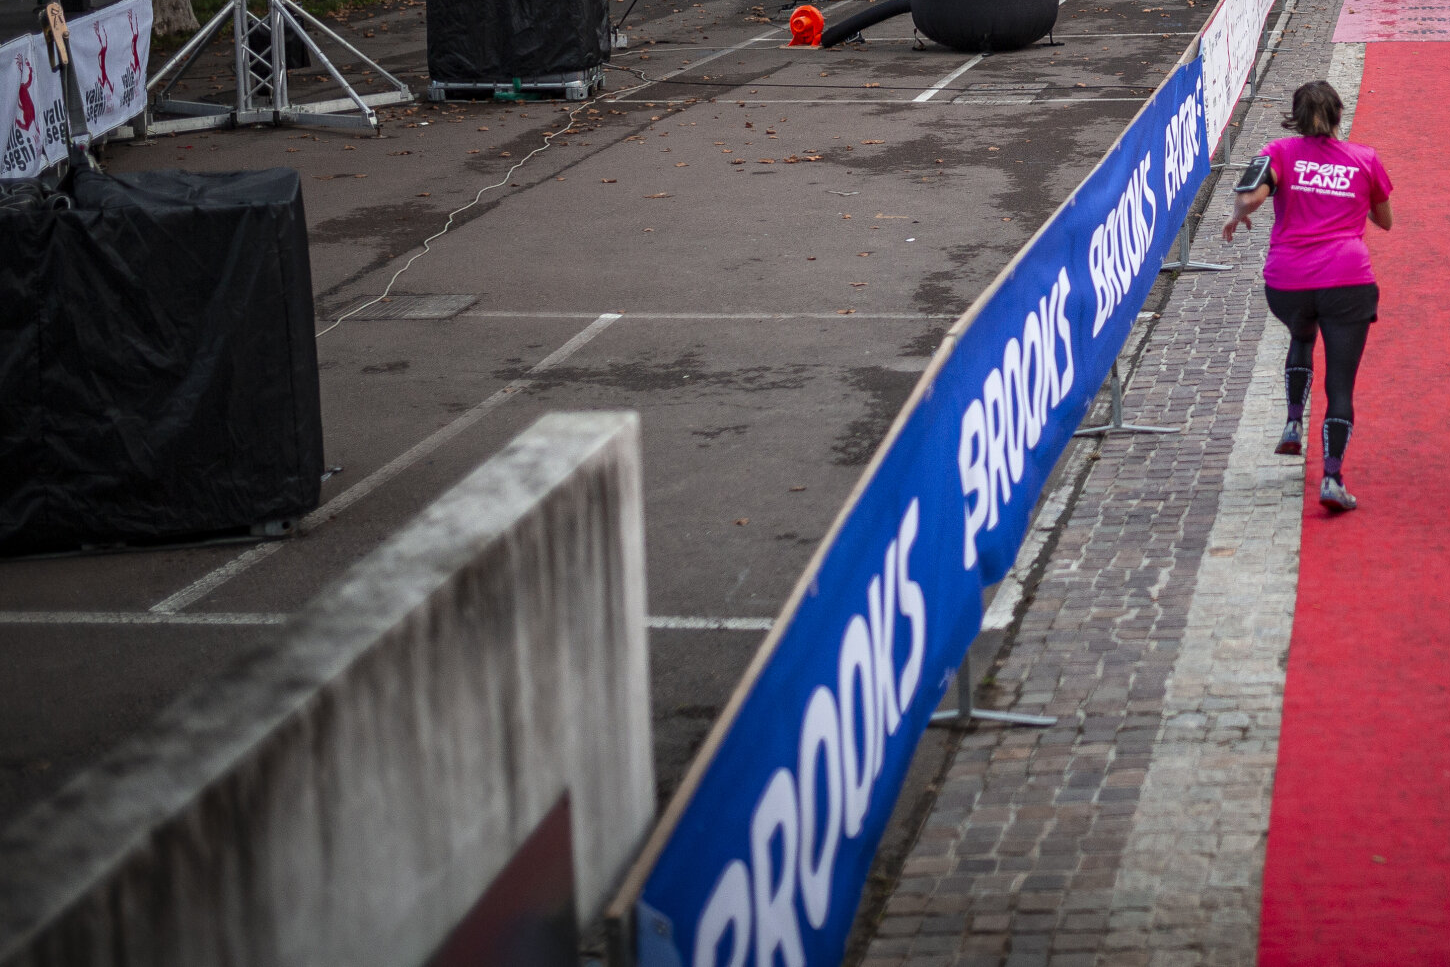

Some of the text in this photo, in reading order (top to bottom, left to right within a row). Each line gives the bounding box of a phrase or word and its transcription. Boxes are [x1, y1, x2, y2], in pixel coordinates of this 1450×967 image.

[46, 122, 67, 145] seg
[1293, 160, 1360, 179] SPORT
[1298, 172, 1351, 190] LAND
[1089, 149, 1157, 339] BROOKS
[959, 267, 1075, 570] BROOKS
